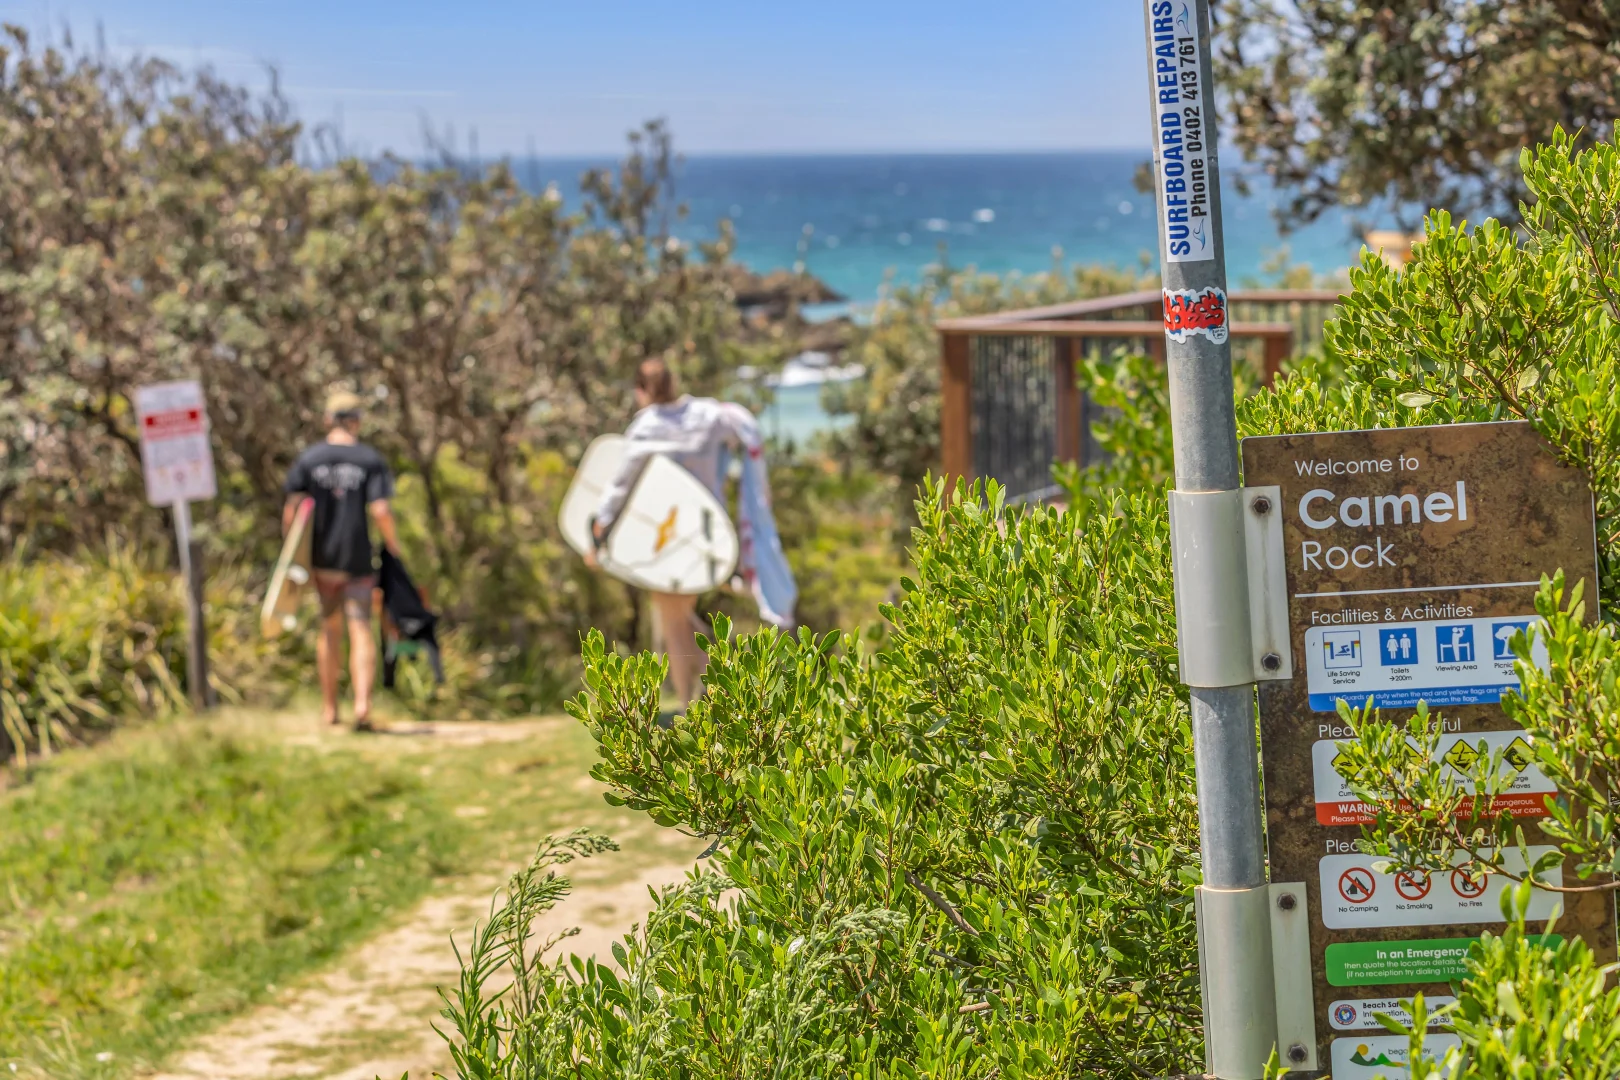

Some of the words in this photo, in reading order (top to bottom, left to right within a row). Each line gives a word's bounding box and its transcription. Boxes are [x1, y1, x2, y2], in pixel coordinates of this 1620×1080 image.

[1152, 1, 1179, 104] REPAIRS
[1178, 37, 1196, 68] 761
[1181, 70, 1198, 100] 413
[1184, 106, 1203, 152] 0402
[1161, 112, 1190, 256] SURFBOARD
[1190, 158, 1207, 217] Phone
[1295, 457, 1393, 477] Welcome
[1398, 454, 1420, 471] to
[1298, 480, 1468, 530] Camel
[1302, 536, 1397, 571] Rock
[1311, 608, 1379, 625] Facilities
[1384, 607, 1397, 622] &
[1401, 603, 1474, 621] Activities
[1449, 688, 1469, 696] yellow
[1470, 687, 1485, 695] flags
[1331, 815, 1355, 823] Please
[1349, 905, 1379, 913] Camping
[1406, 902, 1433, 911] Smoking
[1362, 962, 1385, 970] quote
[1400, 959, 1431, 967] location
[1432, 958, 1456, 966] details
[1376, 950, 1387, 959] In
[1389, 951, 1404, 959] an
[1406, 948, 1469, 958] Emergency
[1405, 969, 1414, 977] try
[1415, 967, 1441, 976] dialing
[1442, 966, 1455, 974] 112
